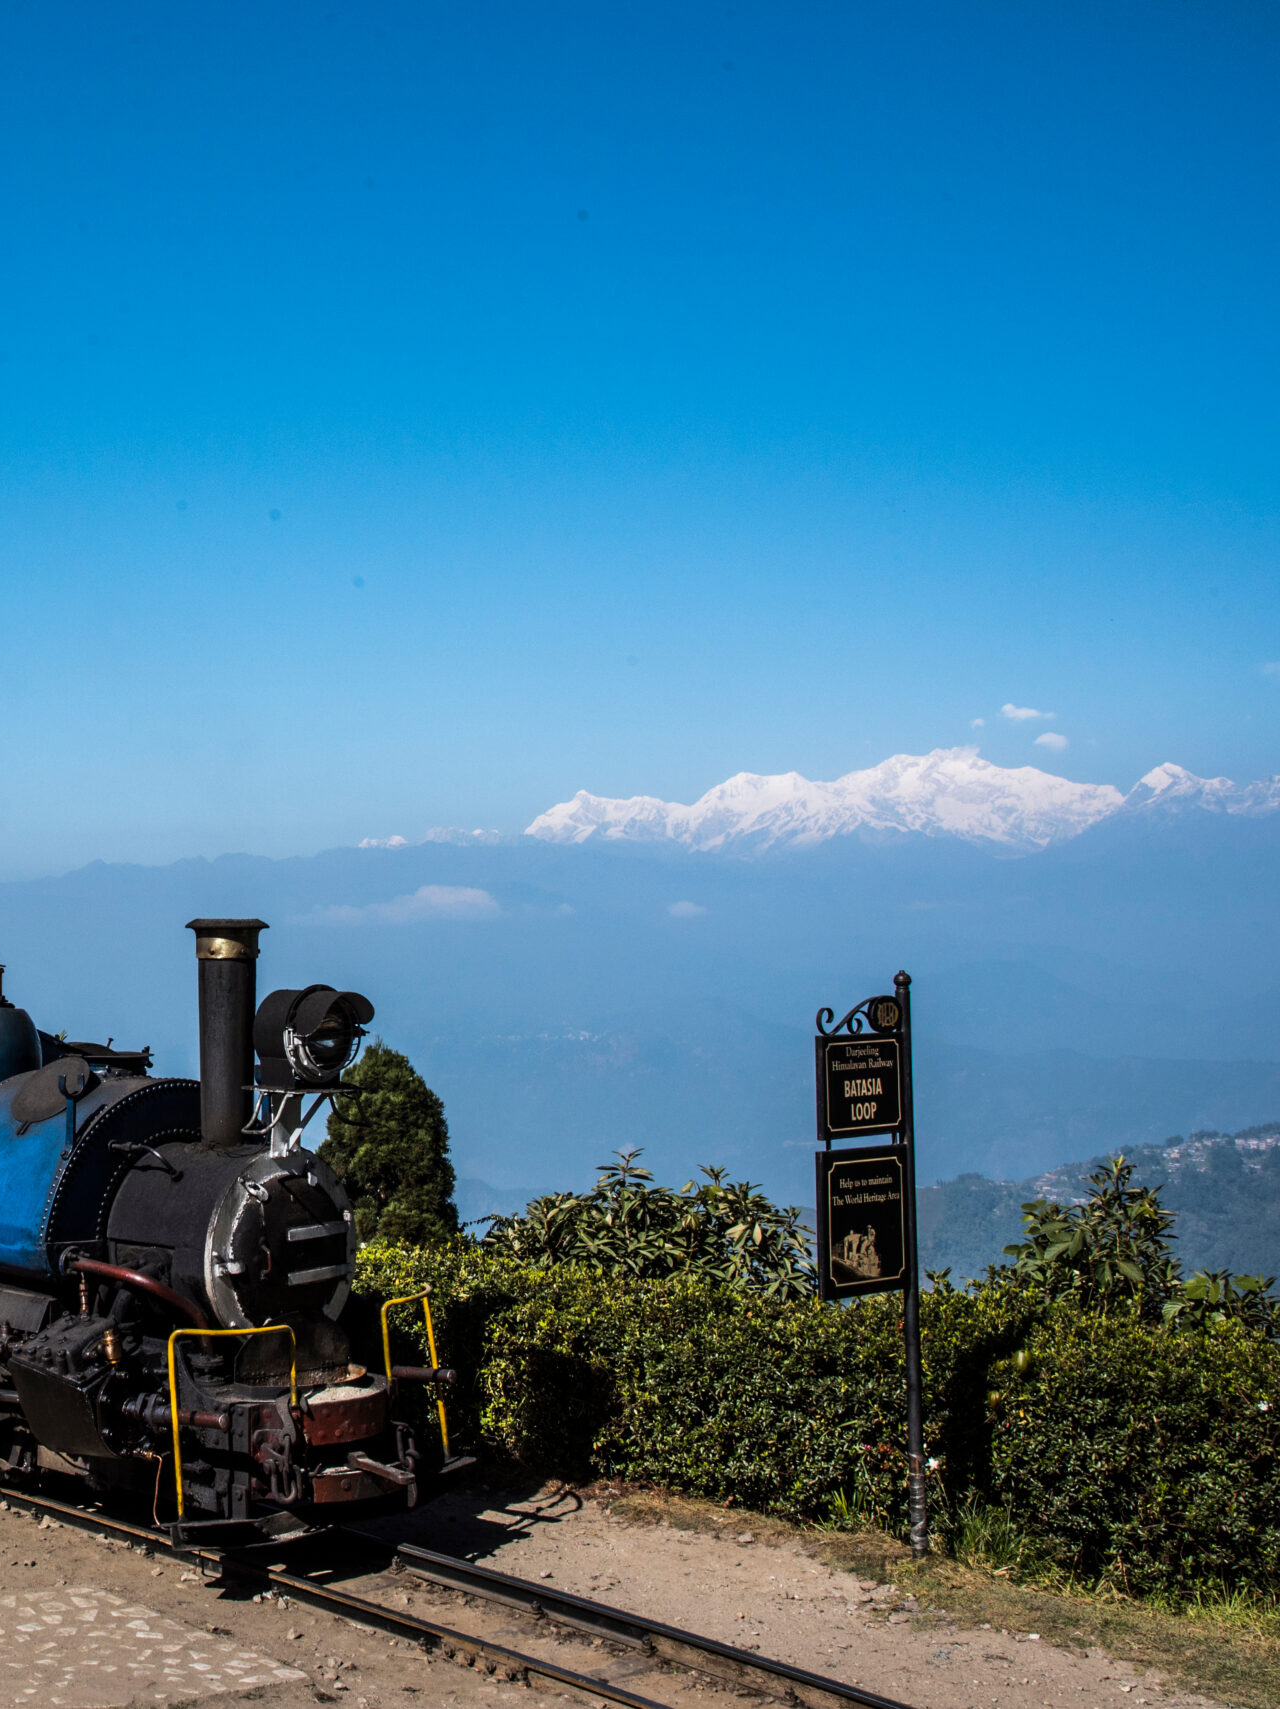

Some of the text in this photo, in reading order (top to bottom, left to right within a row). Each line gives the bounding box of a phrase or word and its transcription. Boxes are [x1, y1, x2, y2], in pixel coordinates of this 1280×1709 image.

[845, 1046, 880, 1058] Darjeeling
[832, 1057, 894, 1071] Himalayan Railway
[844, 1077, 883, 1098] BATASIA
[851, 1102, 877, 1121] LOOP
[839, 1178, 853, 1190] Help
[861, 1179, 868, 1187] to
[868, 1174, 893, 1185] maintain
[832, 1190, 900, 1206] The World Heritage Area
